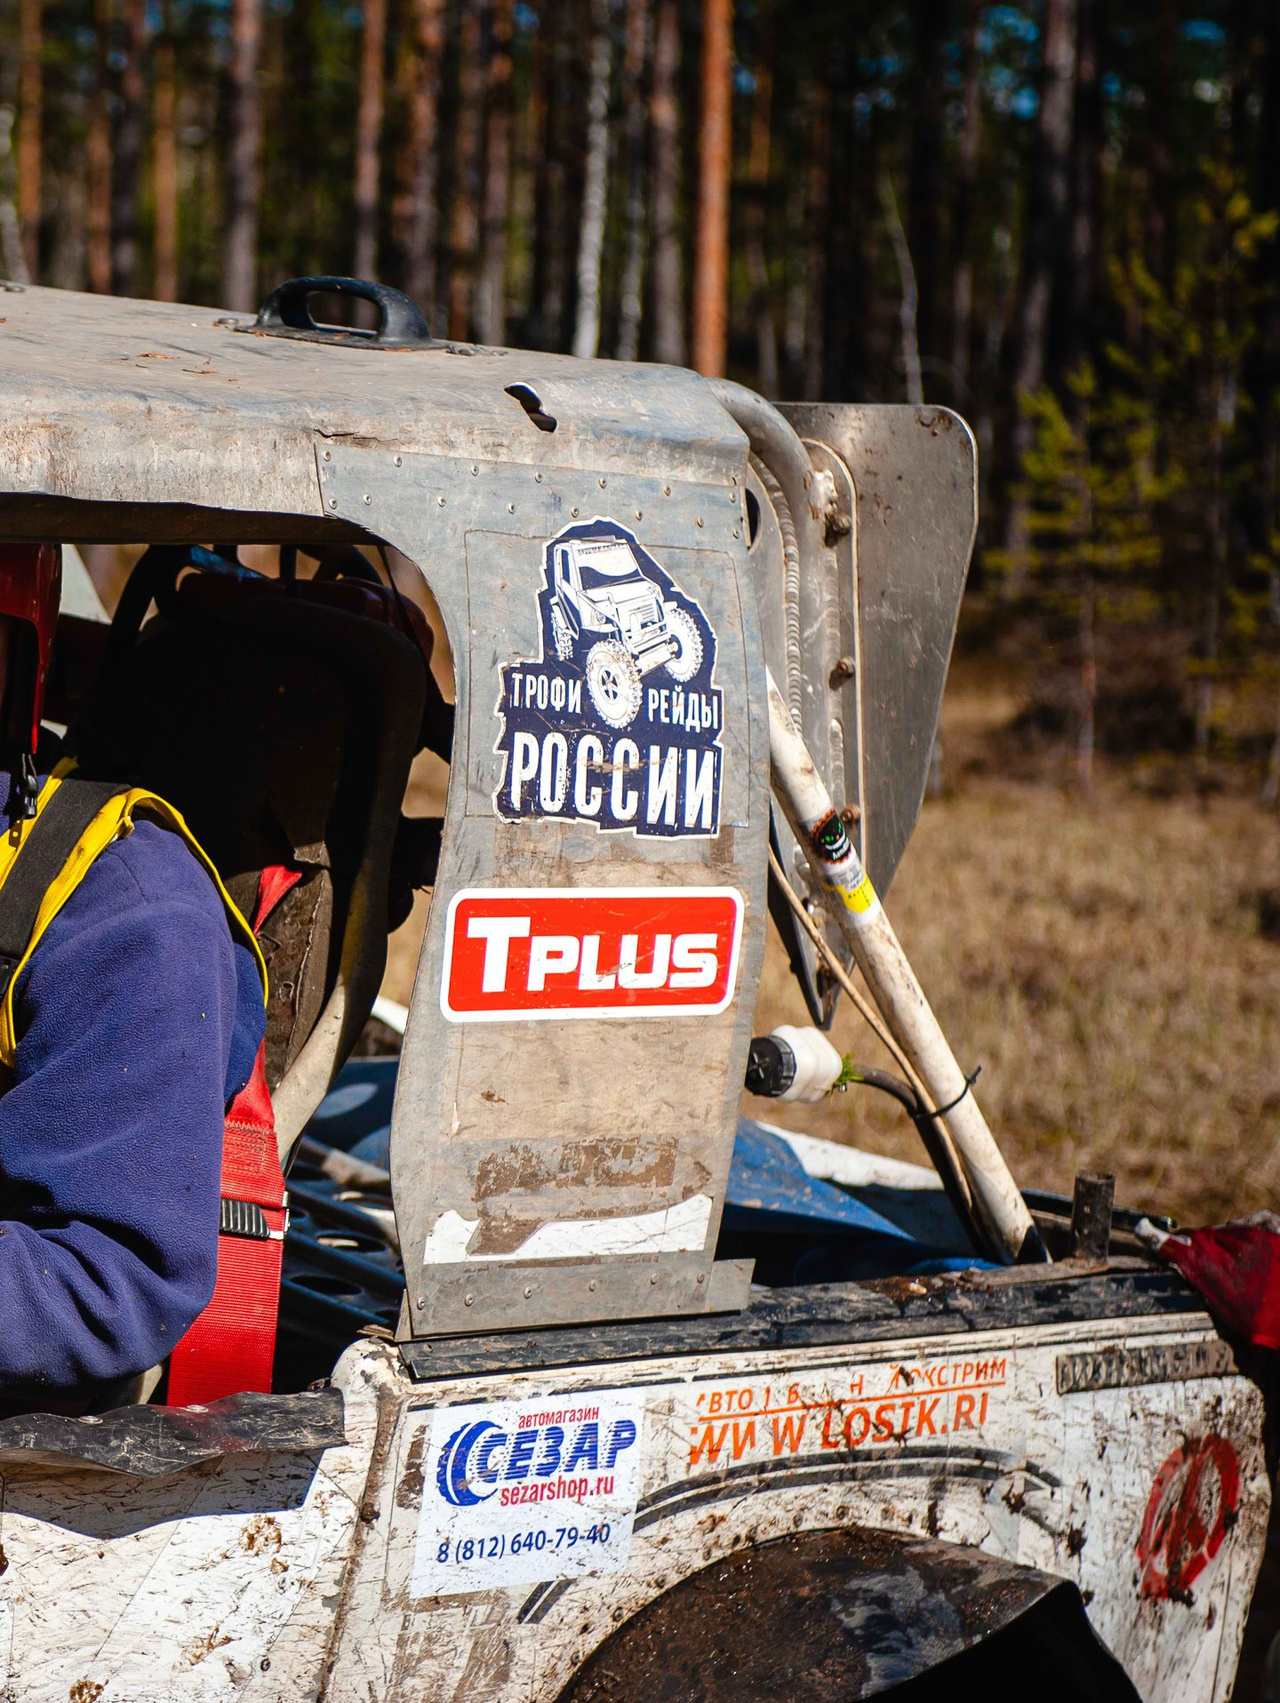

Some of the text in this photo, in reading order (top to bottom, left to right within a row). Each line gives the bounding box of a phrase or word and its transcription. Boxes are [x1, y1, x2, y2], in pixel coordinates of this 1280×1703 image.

[512, 672, 719, 733] ТРОФИ РЕЙДЫ
[509, 731, 716, 829] РОССИИ
[467, 916, 719, 993] TPLUS
[518, 1407, 600, 1430] автомагазин
[469, 1419, 637, 1484] СЕЗАР
[500, 1475, 615, 1508] sezarshop.ru
[436, 1523, 612, 1564] 8 (812) 640-79-40
